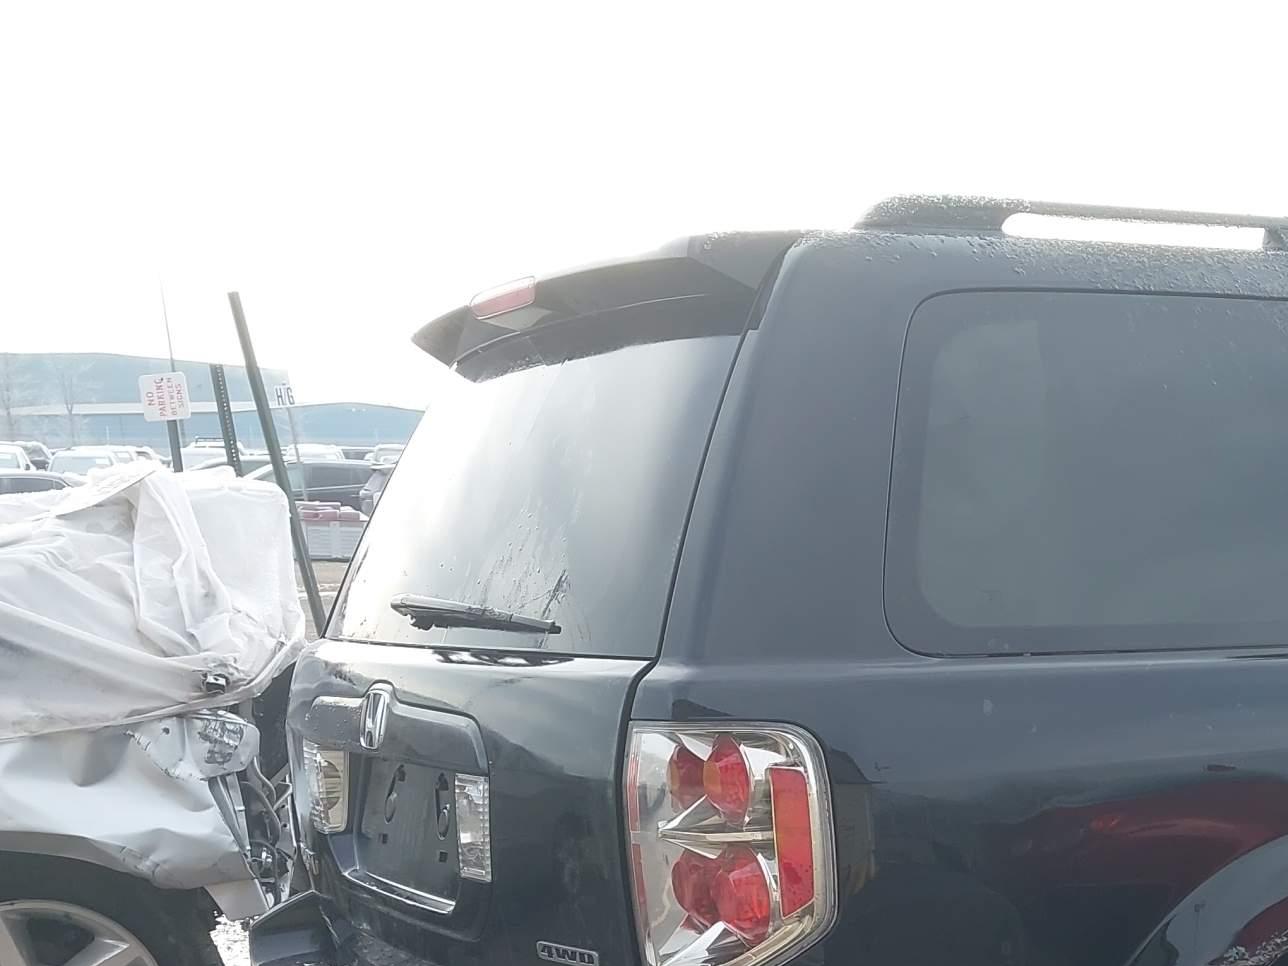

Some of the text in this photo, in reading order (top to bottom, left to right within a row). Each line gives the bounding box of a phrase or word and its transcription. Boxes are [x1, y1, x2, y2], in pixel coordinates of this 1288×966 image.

[145, 391, 156, 406] NO
[153, 377, 167, 417] PARKING
[165, 377, 177, 416] BETWEEN
[175, 383, 184, 409] SIGNS
[540, 944, 595, 966] 4WD
